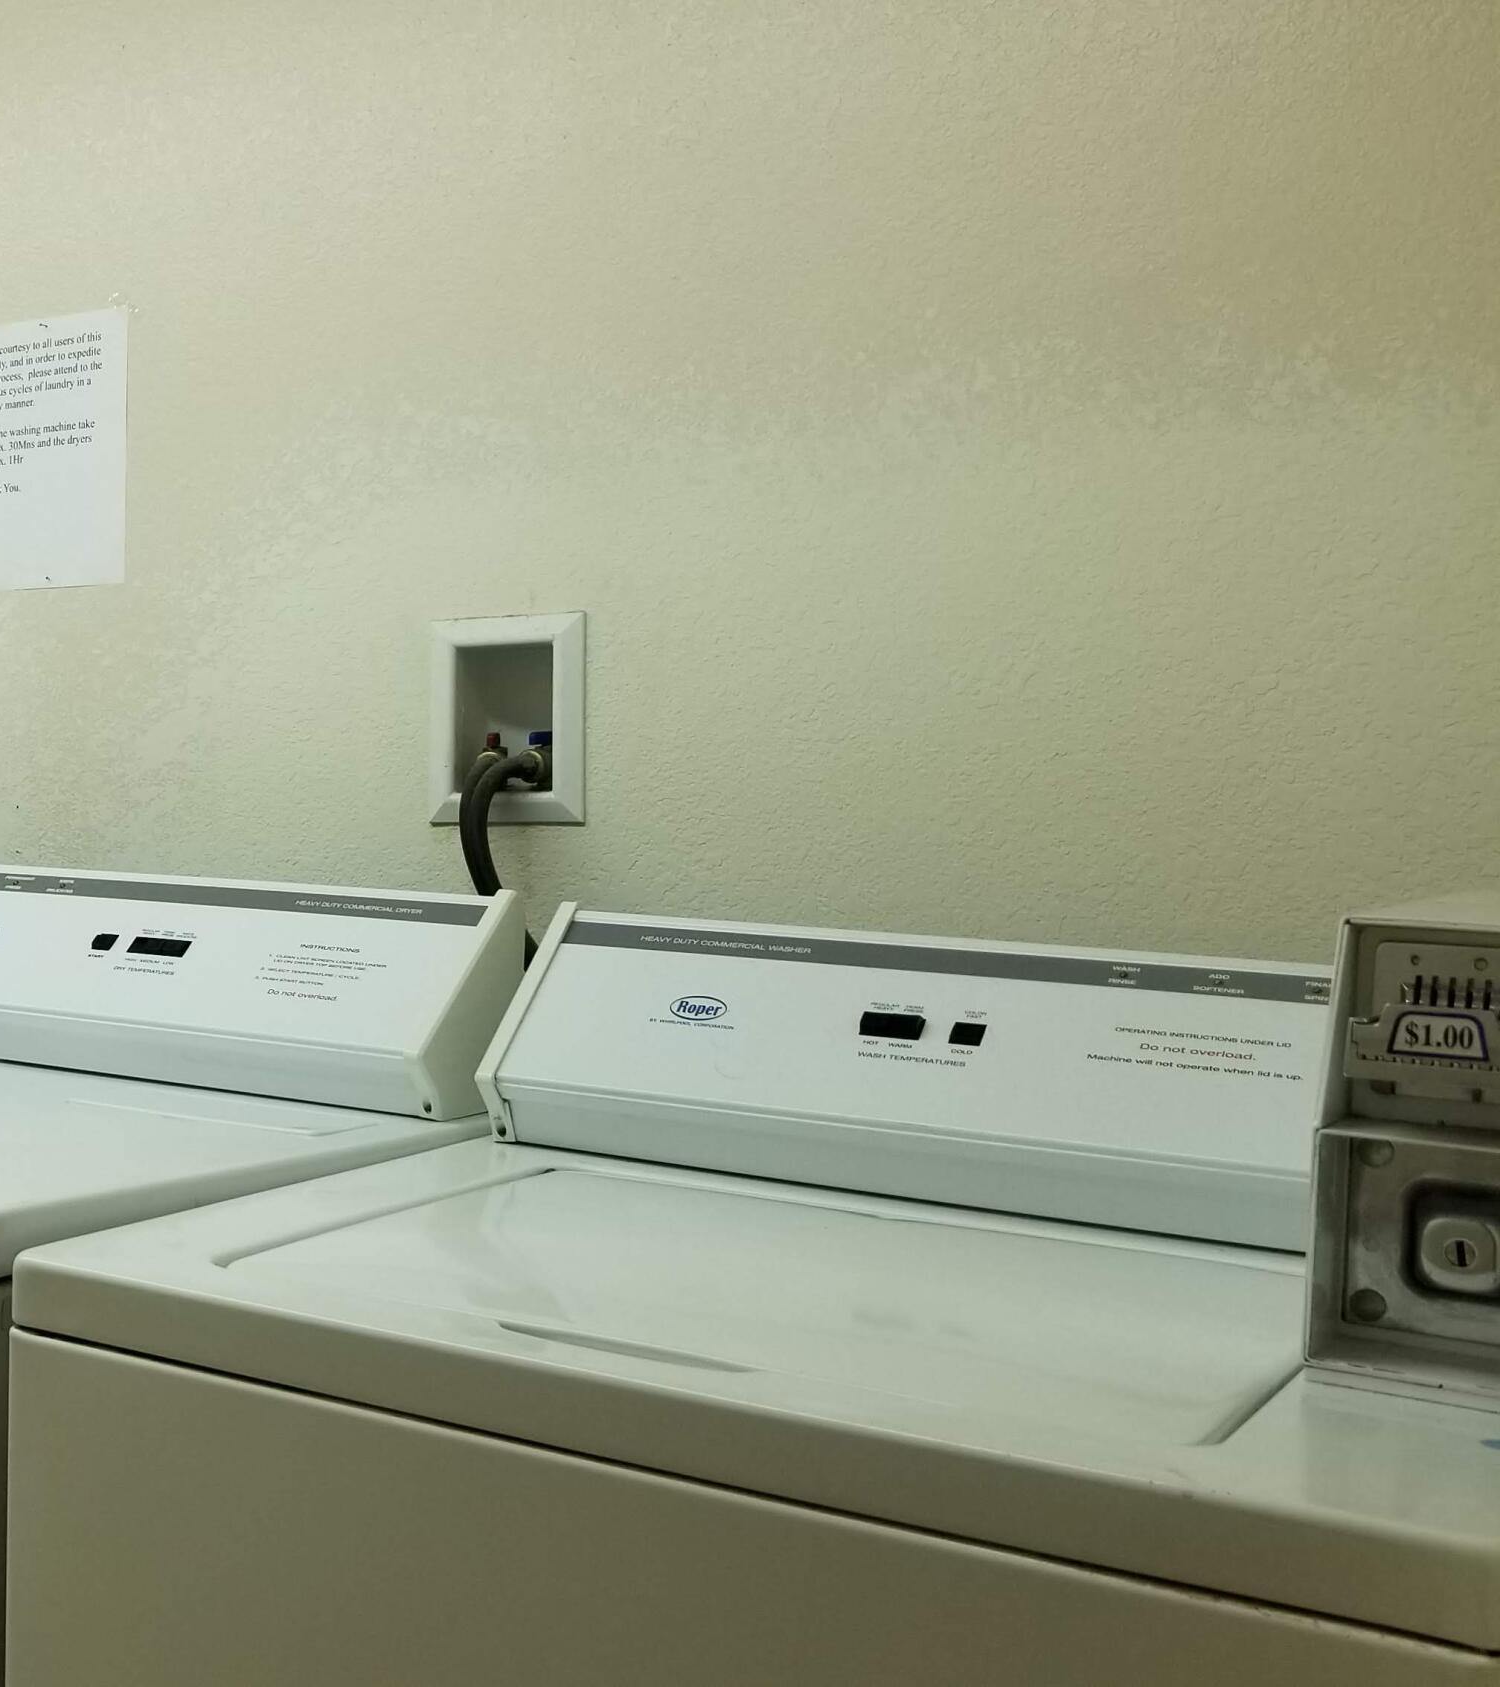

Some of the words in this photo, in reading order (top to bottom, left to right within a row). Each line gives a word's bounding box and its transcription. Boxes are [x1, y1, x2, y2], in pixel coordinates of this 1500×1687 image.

[0, 344, 30, 354] courtesy
[43, 339, 51, 348] all
[55, 336, 74, 346] users
[77, 334, 86, 343] of
[88, 331, 101, 341] this
[10, 357, 23, 367] and
[26, 357, 33, 365] in
[36, 353, 55, 364] order
[68, 346, 101, 361] expedite
[28, 368, 52, 380] please
[54, 363, 78, 375] attend
[80, 364, 88, 372] to
[91, 361, 102, 370] the
[9, 385, 32, 397] cycles
[35, 383, 43, 392] of
[45, 379, 74, 391] laundry
[9, 426, 40, 436] washing
[43, 421, 76, 433] machine
[79, 419, 95, 429] take
[9, 440, 35, 451] 30Mns
[37, 437, 51, 448] and
[54, 437, 65, 446] the
[68, 435, 92, 447] dryers
[9, 455, 23, 464] 1Hr
[343, 903, 393, 913] COMMERCIAL
[300, 944, 360, 953] INSTRUCTIONS
[640, 935, 672, 943] HEAVY
[673, 937, 700, 945] DUTY
[700, 940, 765, 951] COMMERCIAL
[769, 945, 812, 954] WASHER
[1193, 985, 1244, 994] SOFTENER
[676, 1000, 722, 1016] Roper
[1115, 1026, 1167, 1037] OPERATING
[1169, 1032, 1238, 1043] INSTRUCTIONS
[1240, 1038, 1274, 1047] UNDER
[1405, 1021, 1473, 1049] $1.00
[858, 1051, 886, 1059] WASH
[890, 1054, 966, 1067] TEMPERATURES
[1139, 1043, 1159, 1051] Do
[1163, 1046, 1185, 1054] not
[1190, 1048, 1256, 1061] overload.
[1086, 1053, 1132, 1063] Machine
[1176, 1062, 1220, 1072] operate
[1223, 1067, 1254, 1076] when
